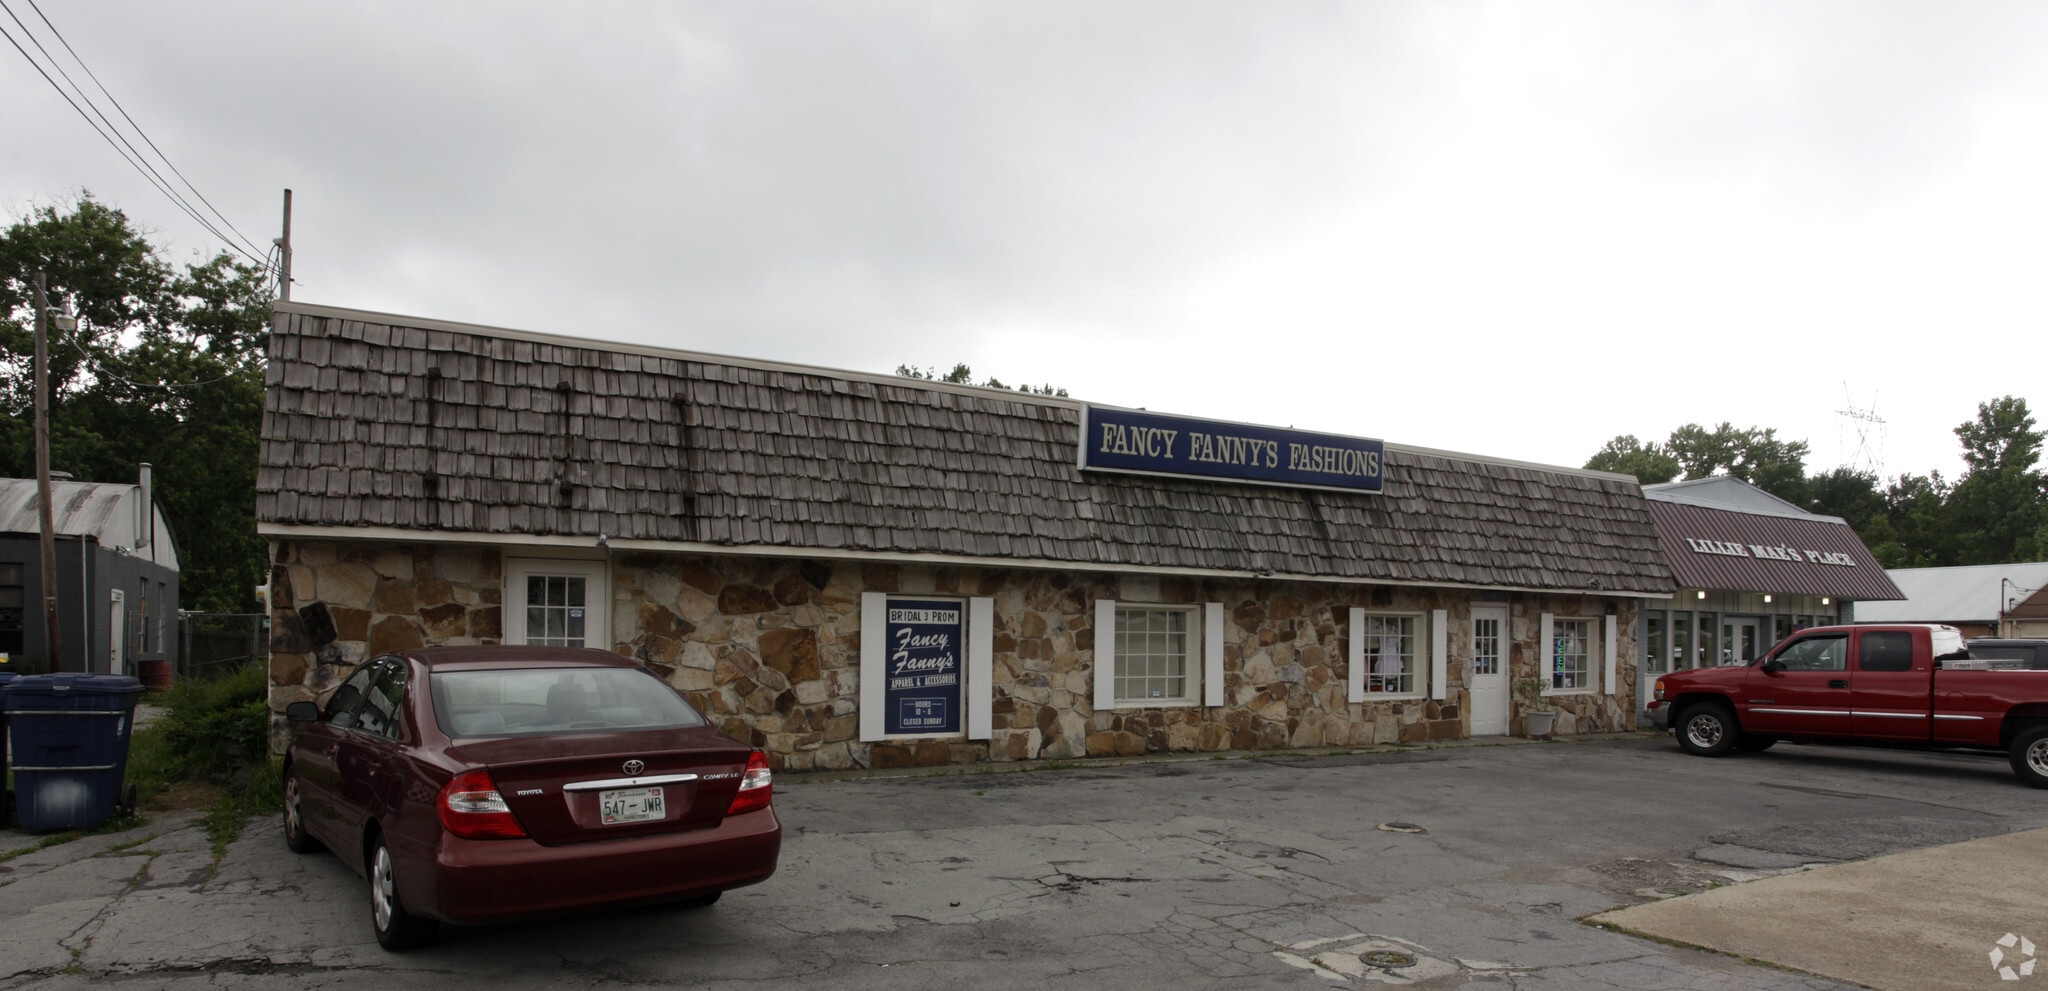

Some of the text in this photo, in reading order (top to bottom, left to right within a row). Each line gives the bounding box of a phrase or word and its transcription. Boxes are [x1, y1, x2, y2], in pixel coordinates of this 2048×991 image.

[1100, 423, 1379, 478] FANCY FANNY'S FASHIONS
[1686, 537, 1856, 567] LILLIE MAE'S PLACE
[891, 610, 921, 621] BRIDAL
[932, 611, 954, 622] PROM
[896, 627, 948, 651] Fancy
[893, 651, 953, 675] Fanny's
[891, 674, 956, 688] APPAREL & ACCESSORIES
[915, 700, 931, 708] HOURS
[923, 717, 942, 725] SUNDAY
[516, 788, 543, 796] TOYOTA
